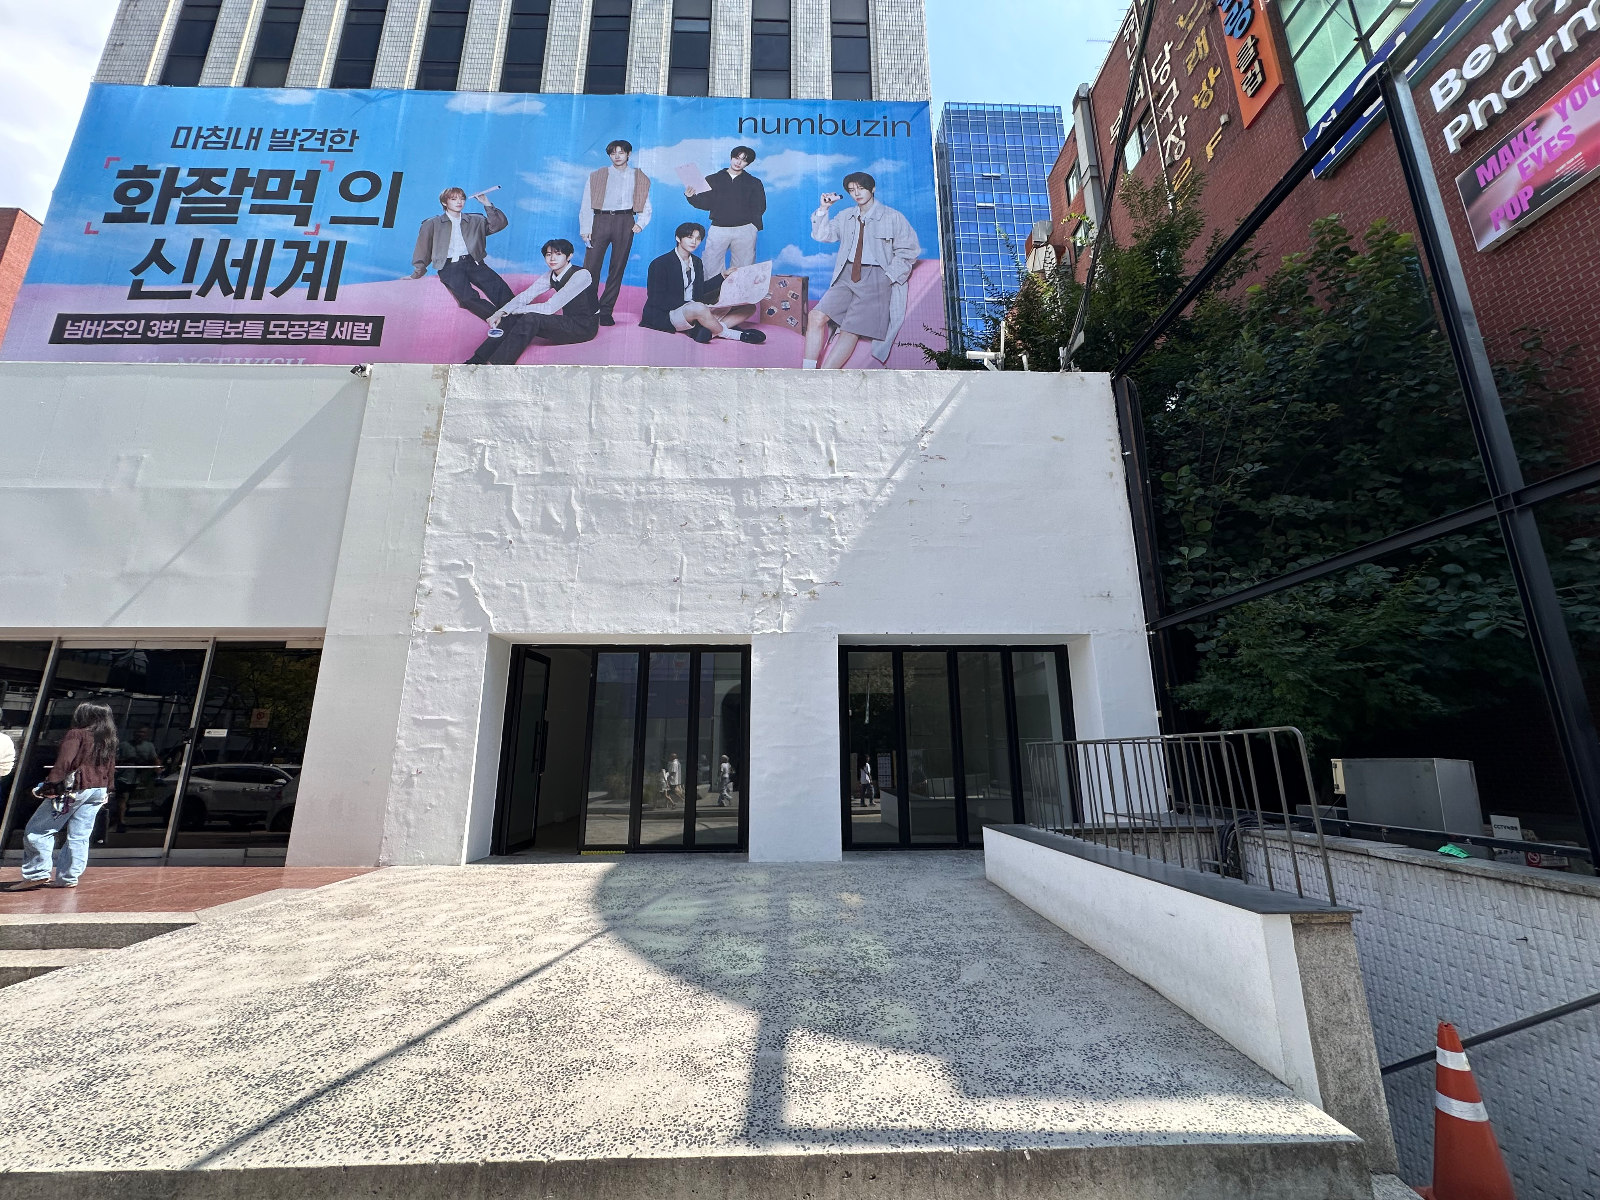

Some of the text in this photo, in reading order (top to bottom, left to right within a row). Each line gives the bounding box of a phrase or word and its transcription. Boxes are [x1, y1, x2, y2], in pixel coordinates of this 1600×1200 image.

[1430, 0, 1573, 114] Berr
[738, 113, 911, 137] numbuzin
[1151, 41, 1188, 161] 당구장
[171, 126, 360, 153] 마침내 발견한
[1475, 120, 1542, 188] MAKE
[1517, 125, 1577, 183] EYES
[1490, 185, 1534, 232] POP
[128, 238, 347, 301] 신세계
[63, 320, 373, 341] 넘버즈인 3번 보들보들 모공결 세럼
